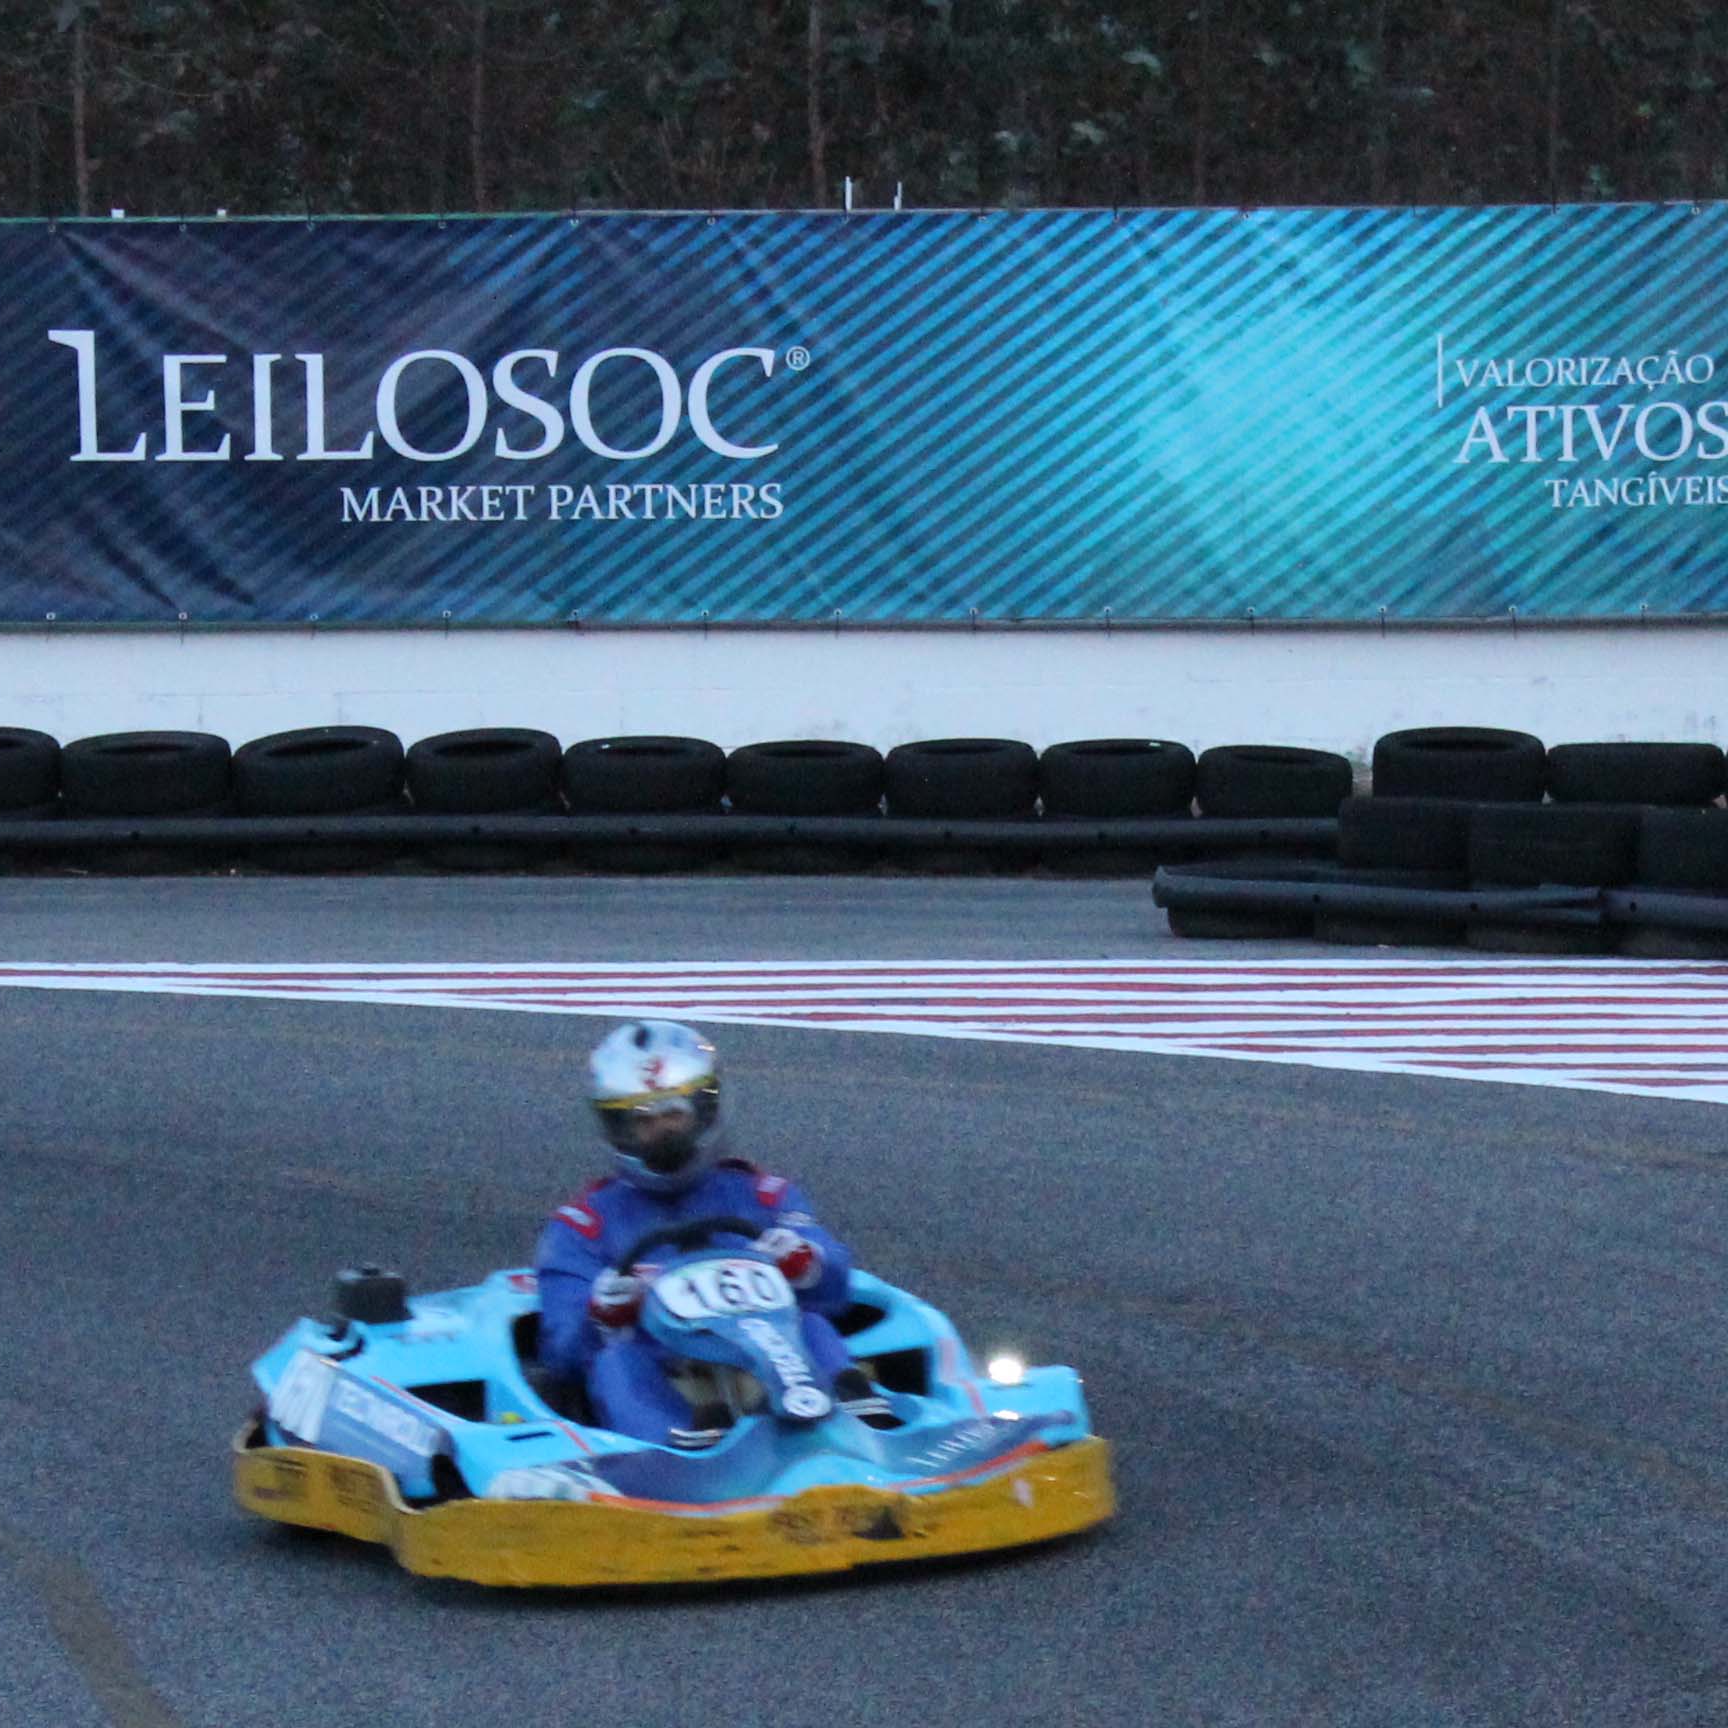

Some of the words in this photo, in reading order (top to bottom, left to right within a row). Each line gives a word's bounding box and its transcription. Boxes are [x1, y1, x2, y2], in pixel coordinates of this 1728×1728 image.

[1455, 346, 1717, 393] VALORIZAÇÃO
[339, 484, 534, 523] MARKET
[548, 482, 785, 521] PARTNERS
